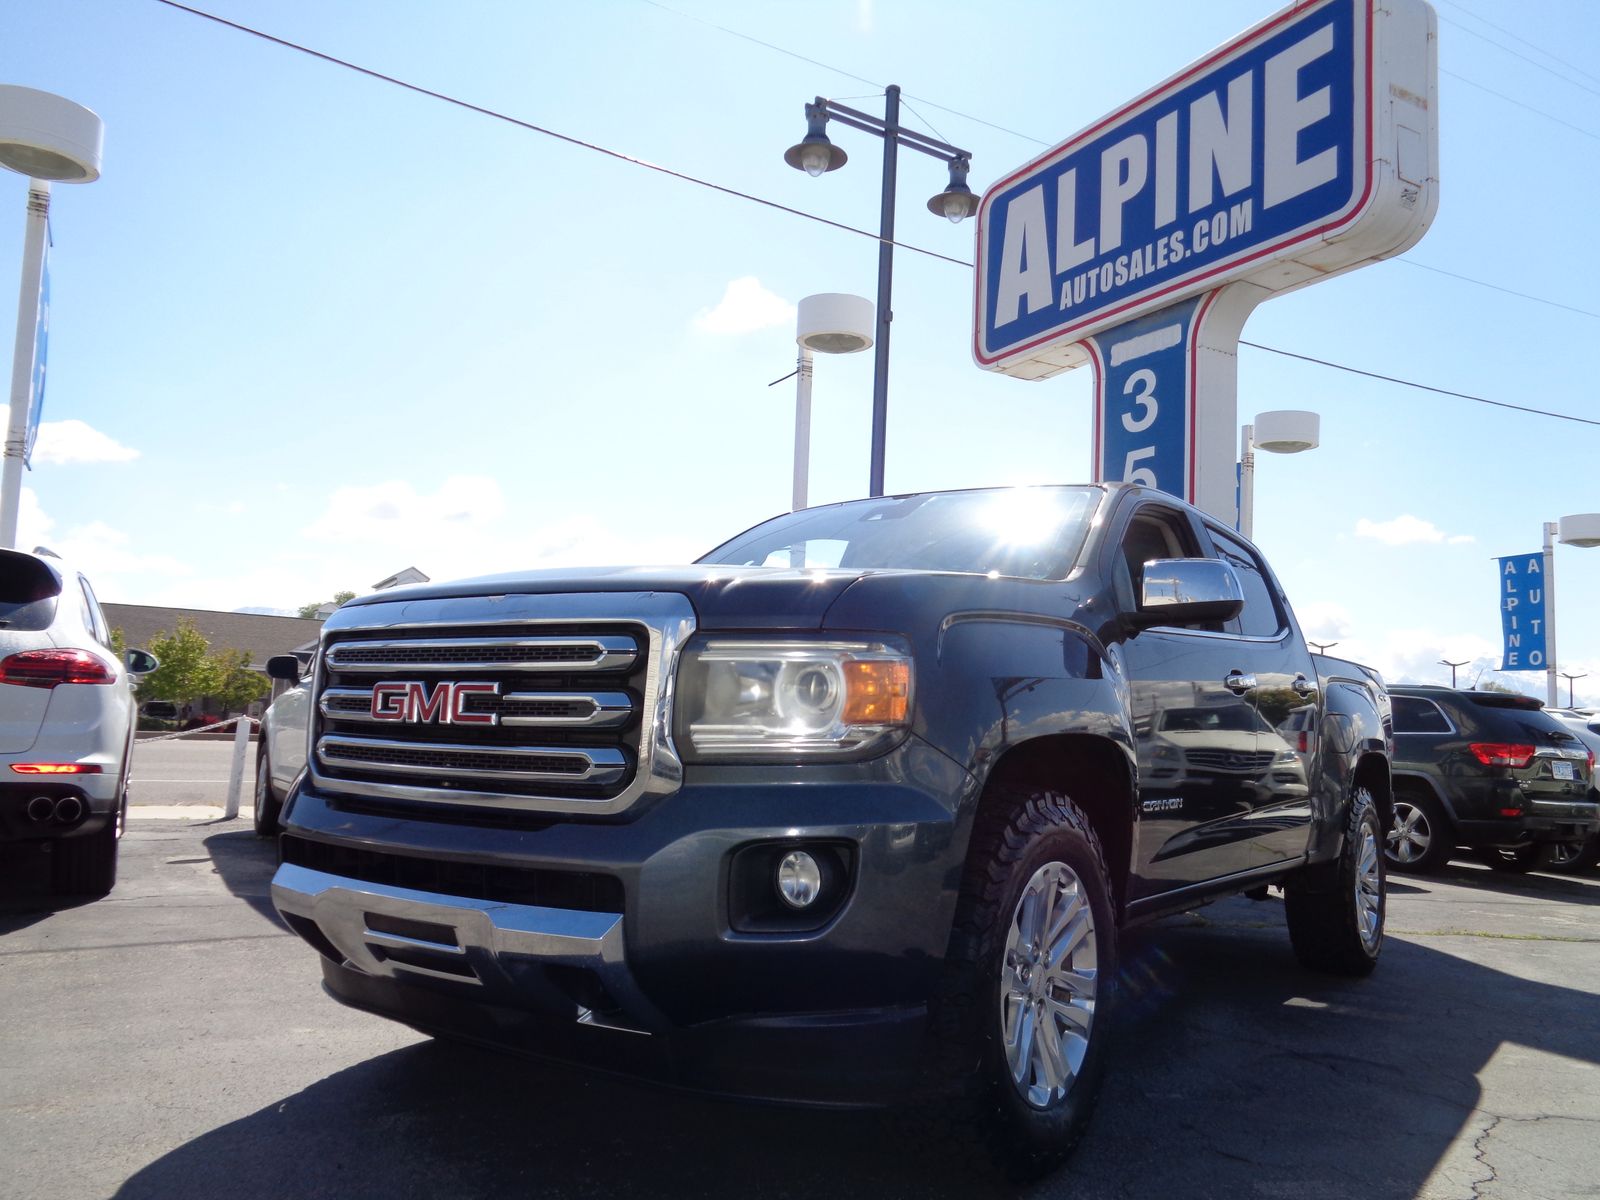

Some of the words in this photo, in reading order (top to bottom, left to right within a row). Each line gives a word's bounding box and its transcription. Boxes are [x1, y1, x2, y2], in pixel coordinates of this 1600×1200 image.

[994, 22, 1338, 329] ALPINE
[1060, 199, 1253, 311] AUTOSALES.COM
[1504, 561, 1521, 666] ALPINE
[1527, 558, 1543, 666] AUTO
[370, 680, 500, 726] GMC
